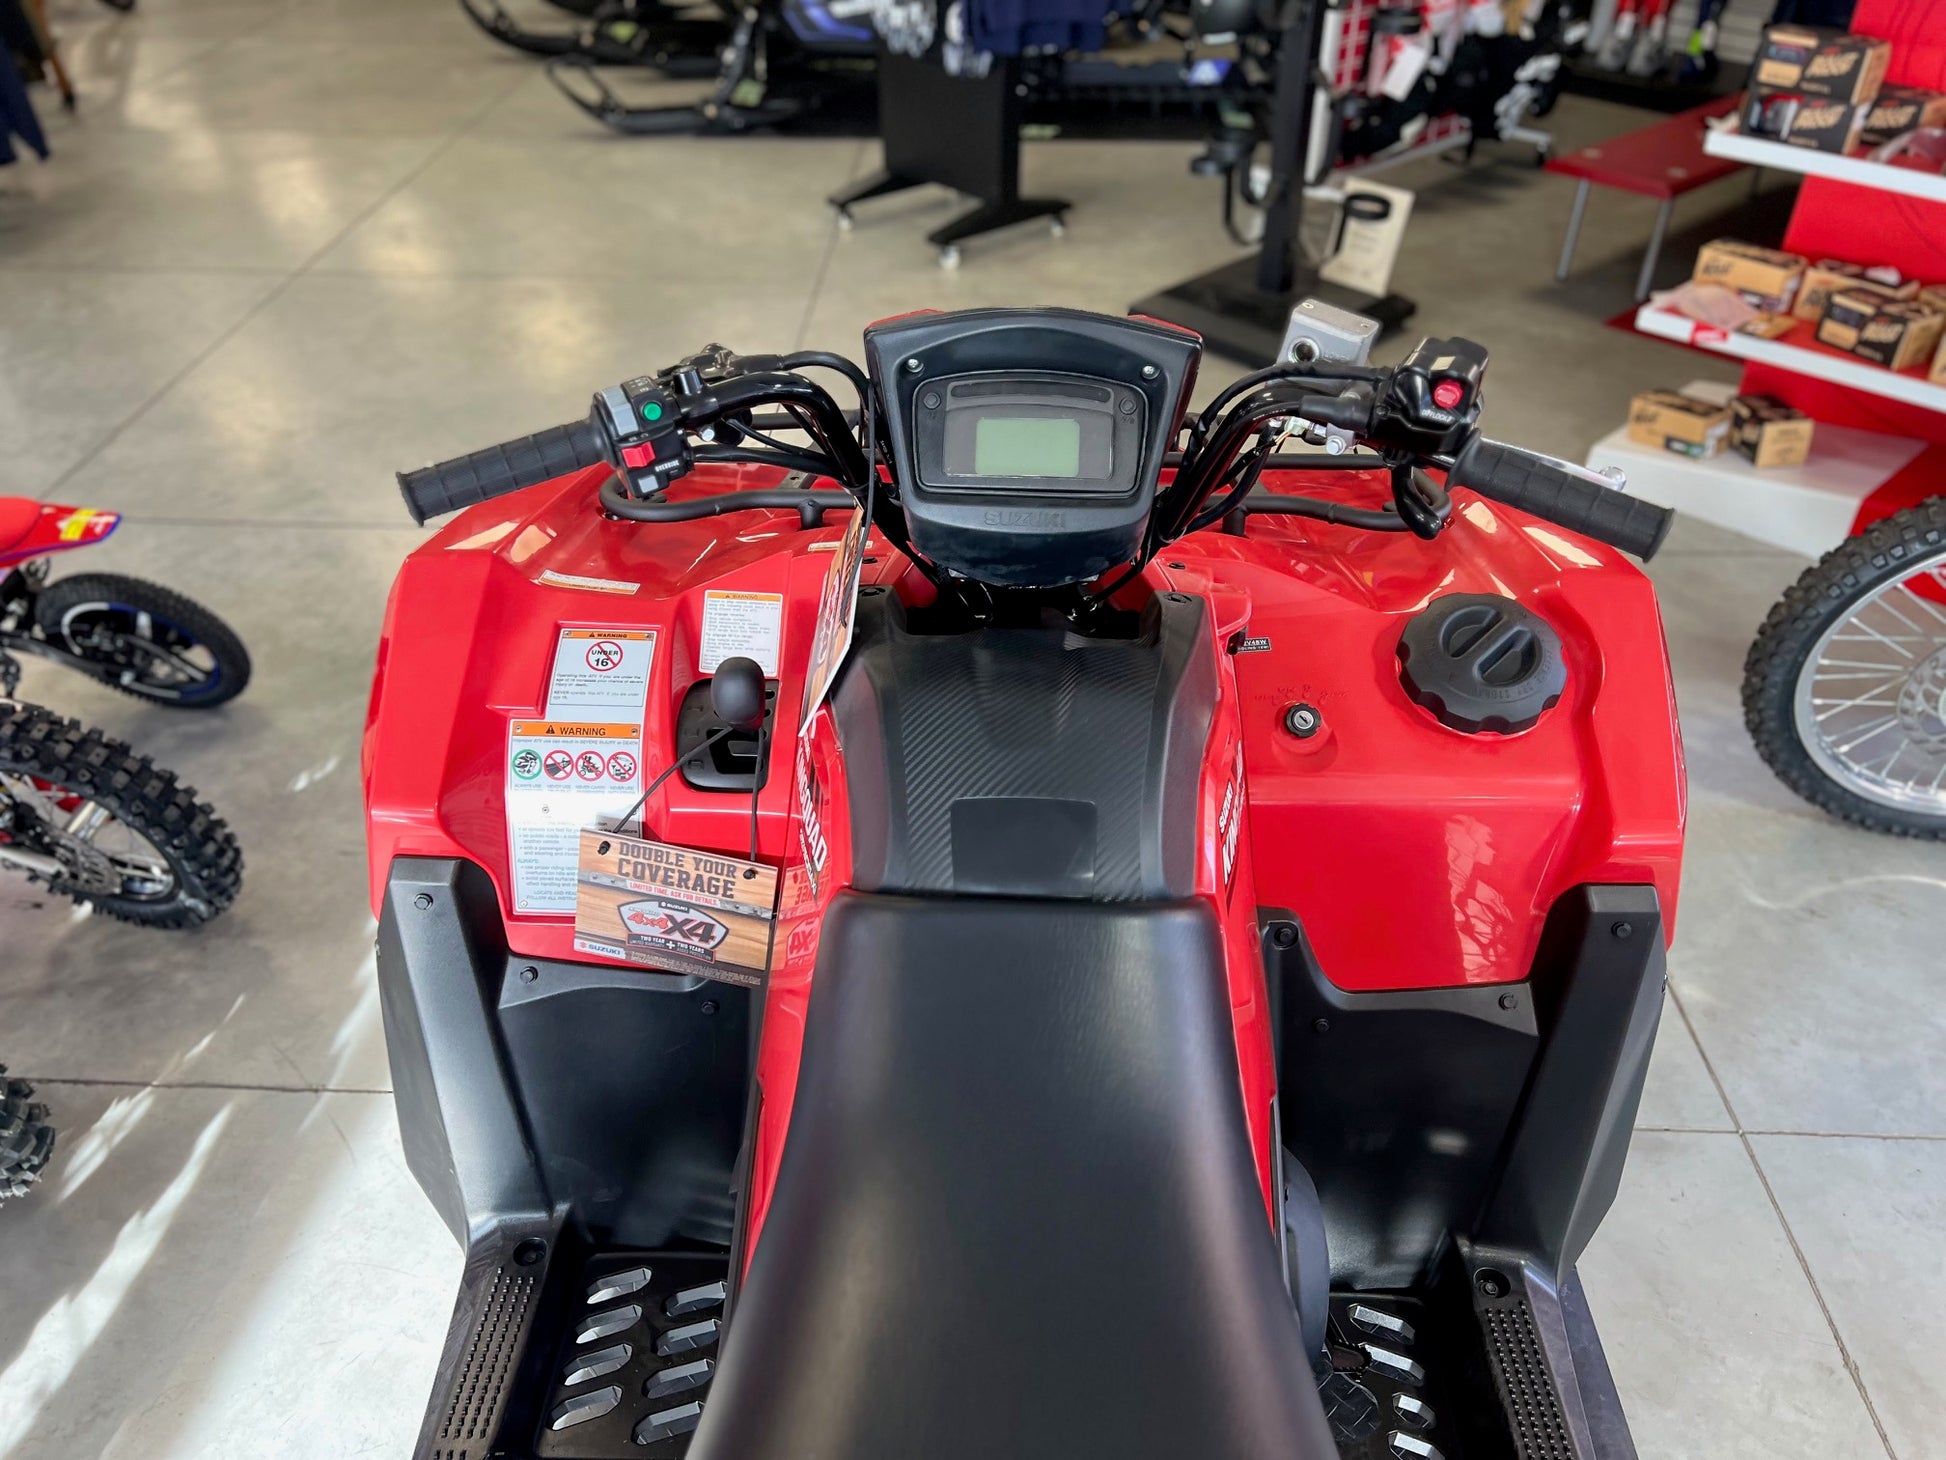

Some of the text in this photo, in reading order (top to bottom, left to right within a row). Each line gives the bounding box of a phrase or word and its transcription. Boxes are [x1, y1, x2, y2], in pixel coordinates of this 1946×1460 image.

[655, 460, 679, 472] OVERRIDE
[984, 511, 1065, 528] SUZUKI
[594, 658, 608, 667] 16
[560, 726, 606, 736] WARNING
[619, 842, 736, 878] DOUBLE YOUR
[618, 858, 736, 898] COVERAGE
[630, 882, 652, 892] LIMITED
[670, 890, 682, 900] ASK
[683, 893, 694, 902] FOR
[695, 894, 718, 906] DETAILS.
[666, 902, 688, 911] SUZUKI
[627, 912, 668, 930] 4x4
[662, 913, 717, 944] X4
[653, 936, 665, 944] YEAR
[588, 944, 620, 956] SUZUKI
[677, 942, 688, 950] TWO
[690, 945, 704, 954] YEARS
